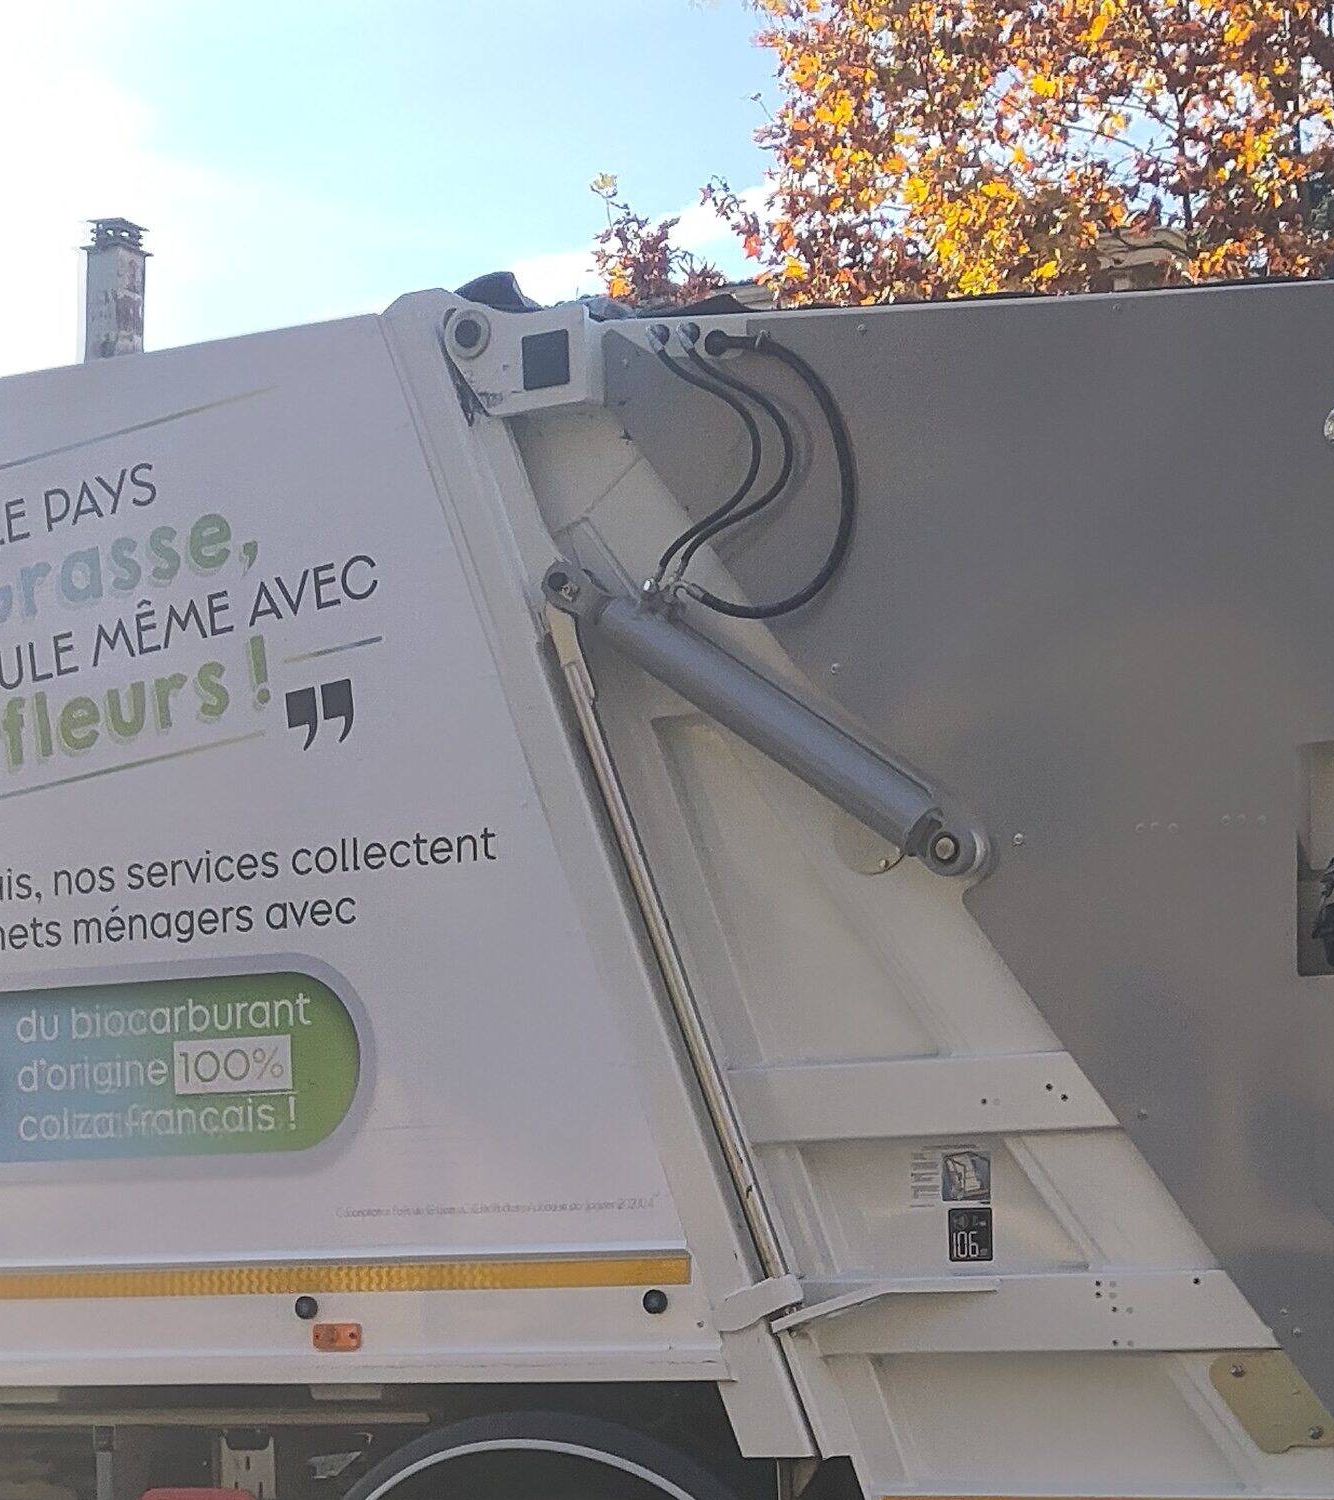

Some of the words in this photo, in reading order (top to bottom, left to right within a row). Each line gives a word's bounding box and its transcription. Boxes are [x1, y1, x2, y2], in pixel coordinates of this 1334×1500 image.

[43, 462, 157, 532] PAYS
[92, 590, 234, 667] MÊME
[248, 555, 378, 627] AVEC
[54, 866, 116, 896] nos
[127, 850, 279, 890] services
[291, 827, 497, 876] collectent
[73, 904, 253, 945] ménagers
[265, 896, 357, 930] avec
[16, 1009, 59, 1043] du
[70, 993, 312, 1040] biocarburant
[18, 1056, 168, 1094] d'origine
[178, 1046, 285, 1084] 100%
[19, 1107, 116, 1141] colza
